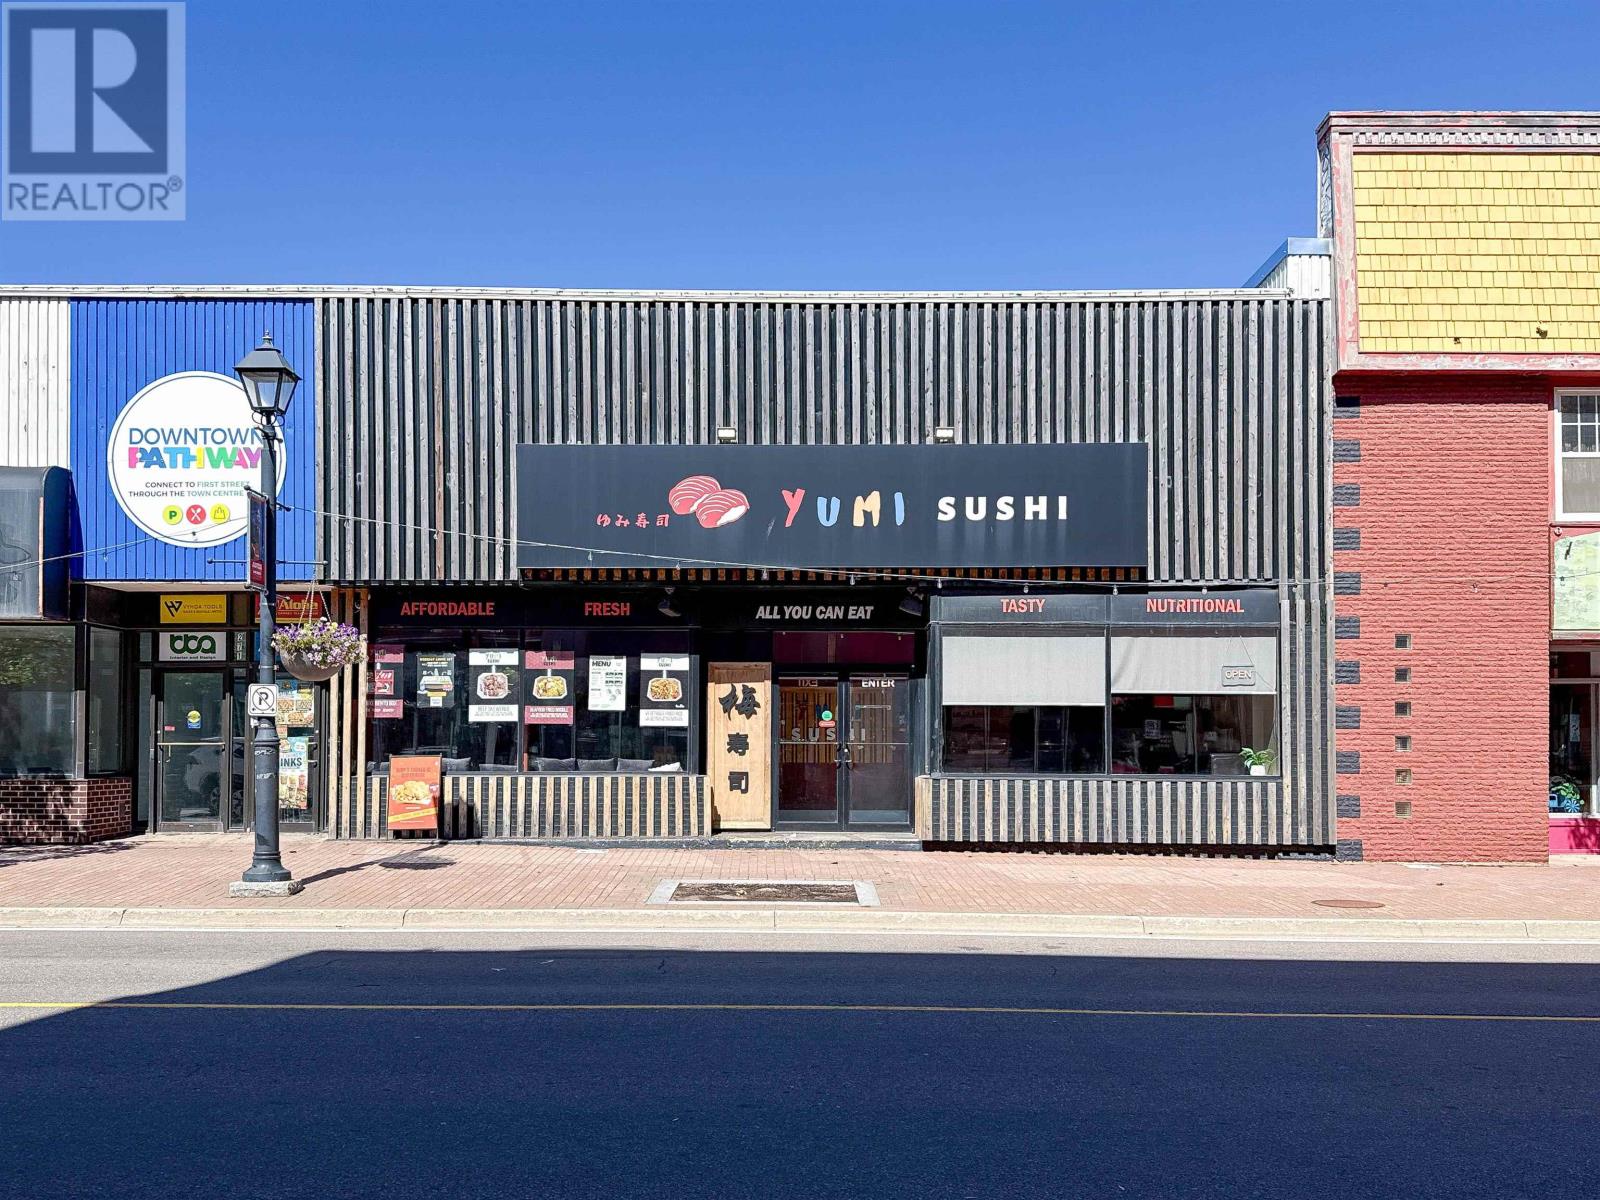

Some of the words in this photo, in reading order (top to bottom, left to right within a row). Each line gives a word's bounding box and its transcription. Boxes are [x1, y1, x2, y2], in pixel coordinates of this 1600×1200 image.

[128, 446, 262, 470] PATHWAY
[129, 490, 168, 498] THROUGH
[212, 489, 244, 497] CENTRE
[169, 510, 178, 519] P
[781, 488, 905, 528] YUMI
[937, 495, 1067, 521] SUSHI
[400, 602, 495, 616] AFFORDABLE
[584, 602, 631, 616] FRESH
[755, 605, 781, 619] ALL
[783, 605, 812, 619] YOU
[815, 605, 844, 619] CAN
[848, 605, 874, 619] EAT
[1000, 599, 1046, 613] TASTY
[1146, 599, 1245, 613] NUTRITIONAL
[1225, 669, 1252, 680] OPEN
[861, 679, 896, 688] ENTER
